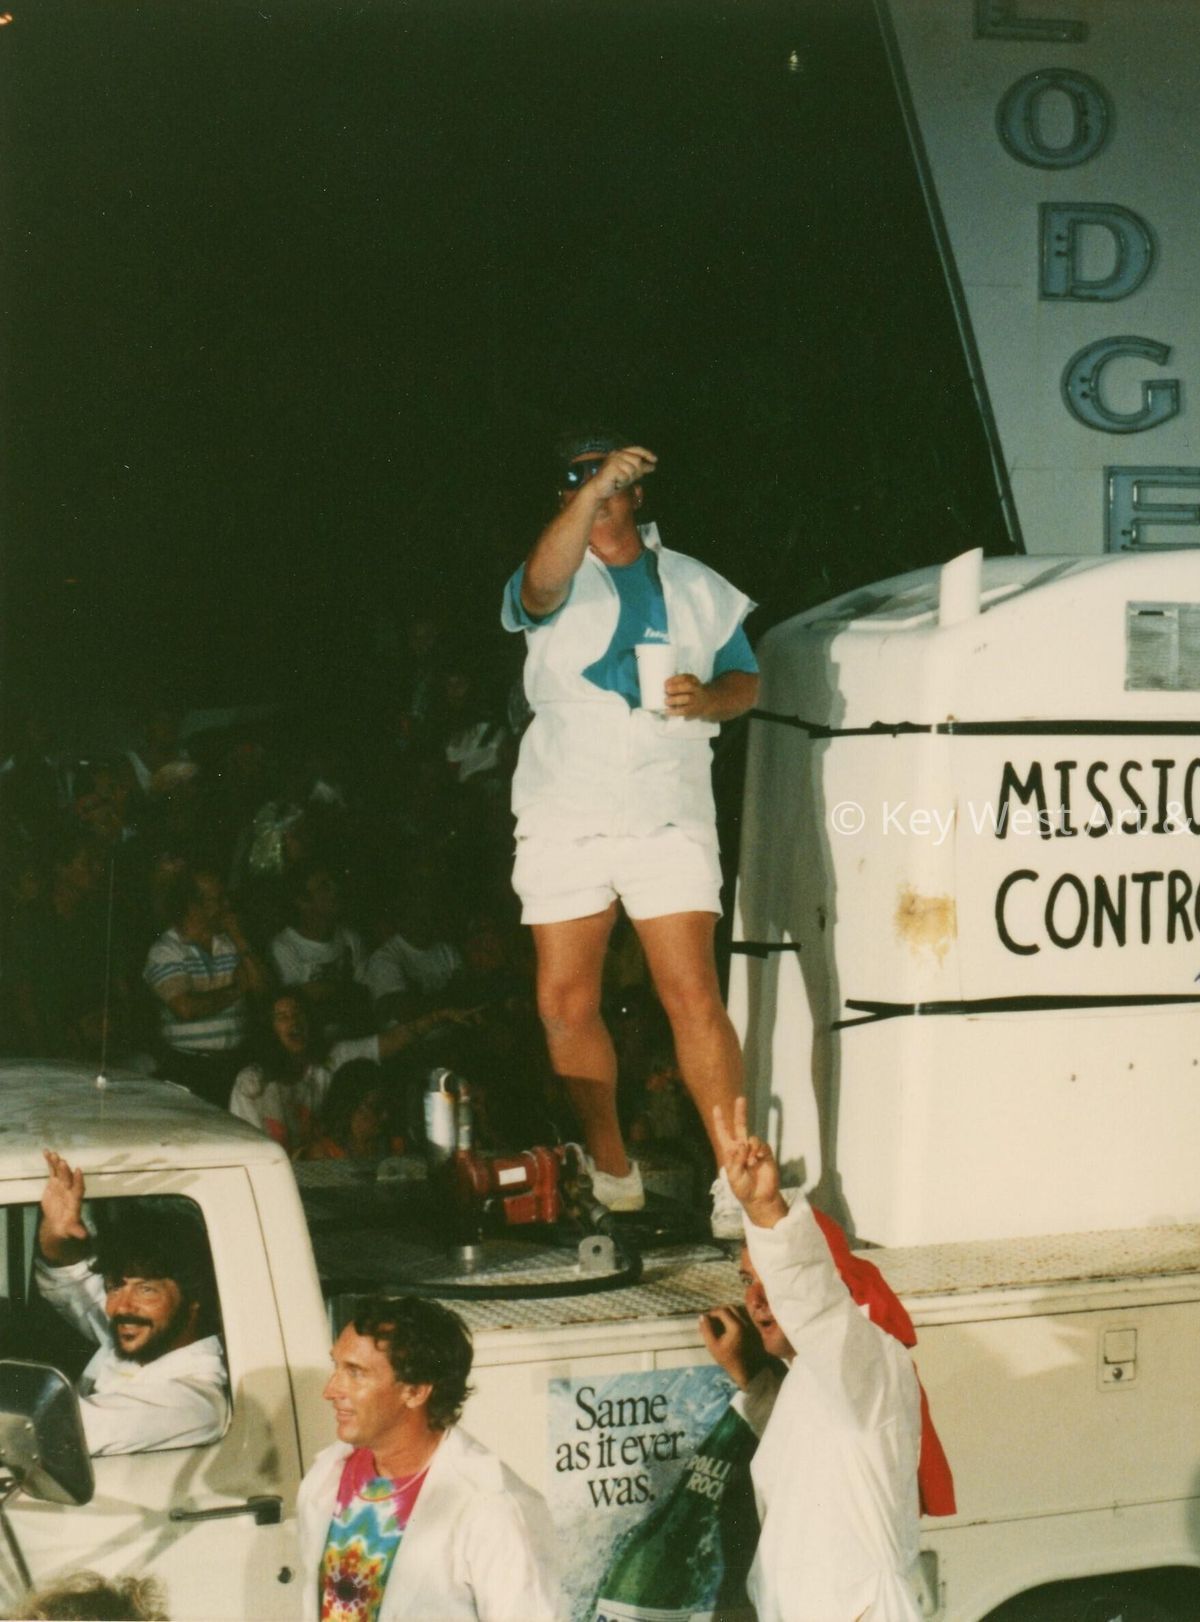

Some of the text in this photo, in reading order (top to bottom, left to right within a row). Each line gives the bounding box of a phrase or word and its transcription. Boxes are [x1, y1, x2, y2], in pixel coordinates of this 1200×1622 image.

[575, 1386, 668, 1431] Same
[555, 1431, 686, 1473] as it ever
[587, 1474, 655, 1508] was.
